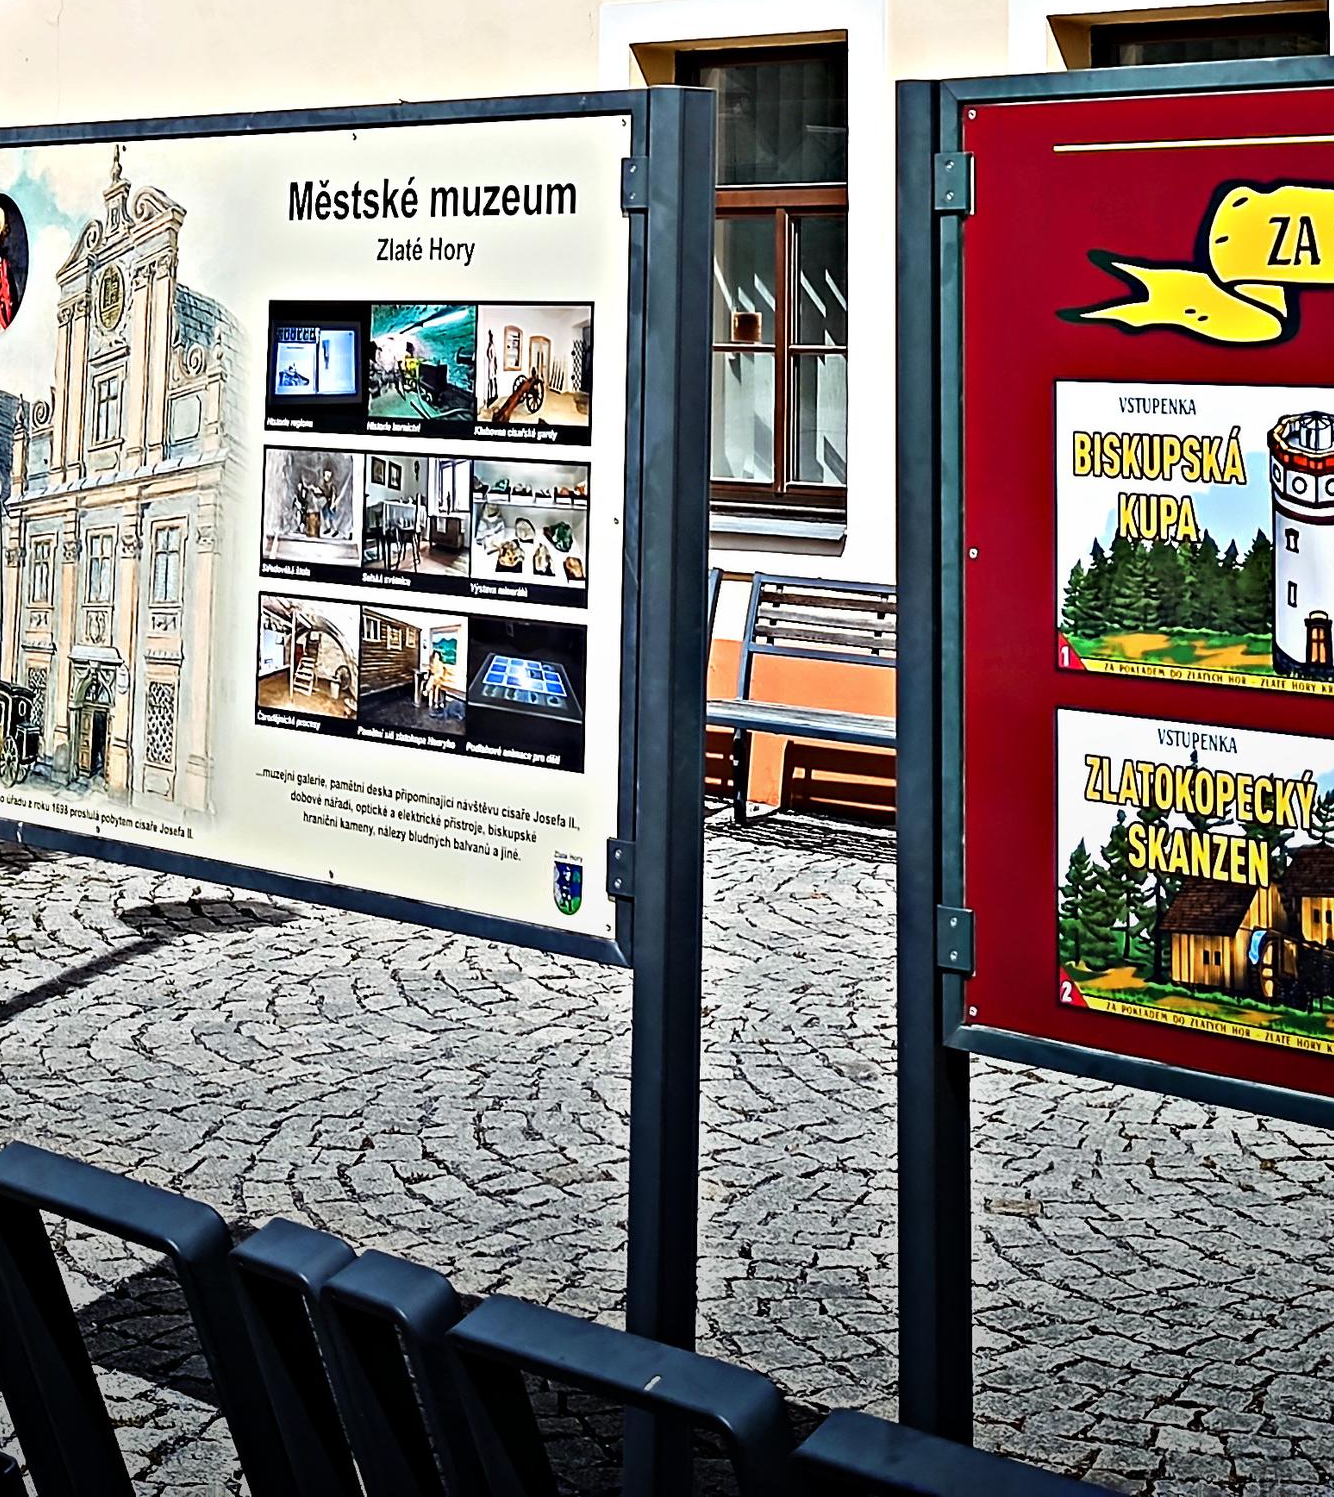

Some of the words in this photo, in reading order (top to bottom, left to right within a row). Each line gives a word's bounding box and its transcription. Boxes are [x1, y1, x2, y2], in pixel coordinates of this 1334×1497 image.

[288, 176, 419, 222] Městské
[430, 181, 577, 218] muzeum
[376, 237, 423, 262] Zlaté
[429, 236, 476, 267] Hory
[1267, 215, 1322, 267] ZA
[1118, 396, 1197, 416] VSTUPENKA
[1073, 425, 1247, 485] BISKUPSKÁ
[1118, 492, 1201, 543] KUPA
[1060, 645, 1070, 667] 1
[1104, 662, 1115, 672] ZA
[1119, 664, 1165, 677] POKLADEM
[1170, 669, 1182, 679] DO
[1228, 675, 1247, 686] HOR
[1291, 682, 1317, 694] HORY
[1157, 728, 1238, 754] VSTUPENKA
[329, 778, 365, 794] pamětní
[366, 783, 393, 798] deska
[456, 799, 499, 816] návštěvu
[501, 805, 531, 822] císaře
[533, 810, 566, 828] Josefa
[1084, 754, 1318, 830] ZLATOKOPECKÝ
[33, 800, 50, 812] roku
[101, 813, 133, 828] pobytem
[160, 822, 185, 838] Josefa
[290, 790, 322, 806] dobové
[355, 802, 388, 817] optické
[390, 809, 395, 818] a
[398, 808, 441, 827] elektrické
[487, 823, 537, 844] biskupské
[303, 810, 338, 828] hraniční
[339, 816, 376, 837] kameny,
[378, 824, 407, 842] nálezy
[408, 830, 451, 849] bludných
[453, 837, 490, 856] balvanů
[493, 847, 499, 857] a
[1126, 820, 1271, 889] SKANZEN
[1060, 980, 1073, 1003] 2
[1106, 1001, 1117, 1012] ZA
[1121, 1004, 1168, 1022] POKLADEM
[1173, 1014, 1185, 1025] DO
[1232, 1026, 1251, 1038] HOR
[1296, 1038, 1321, 1051] HORY
